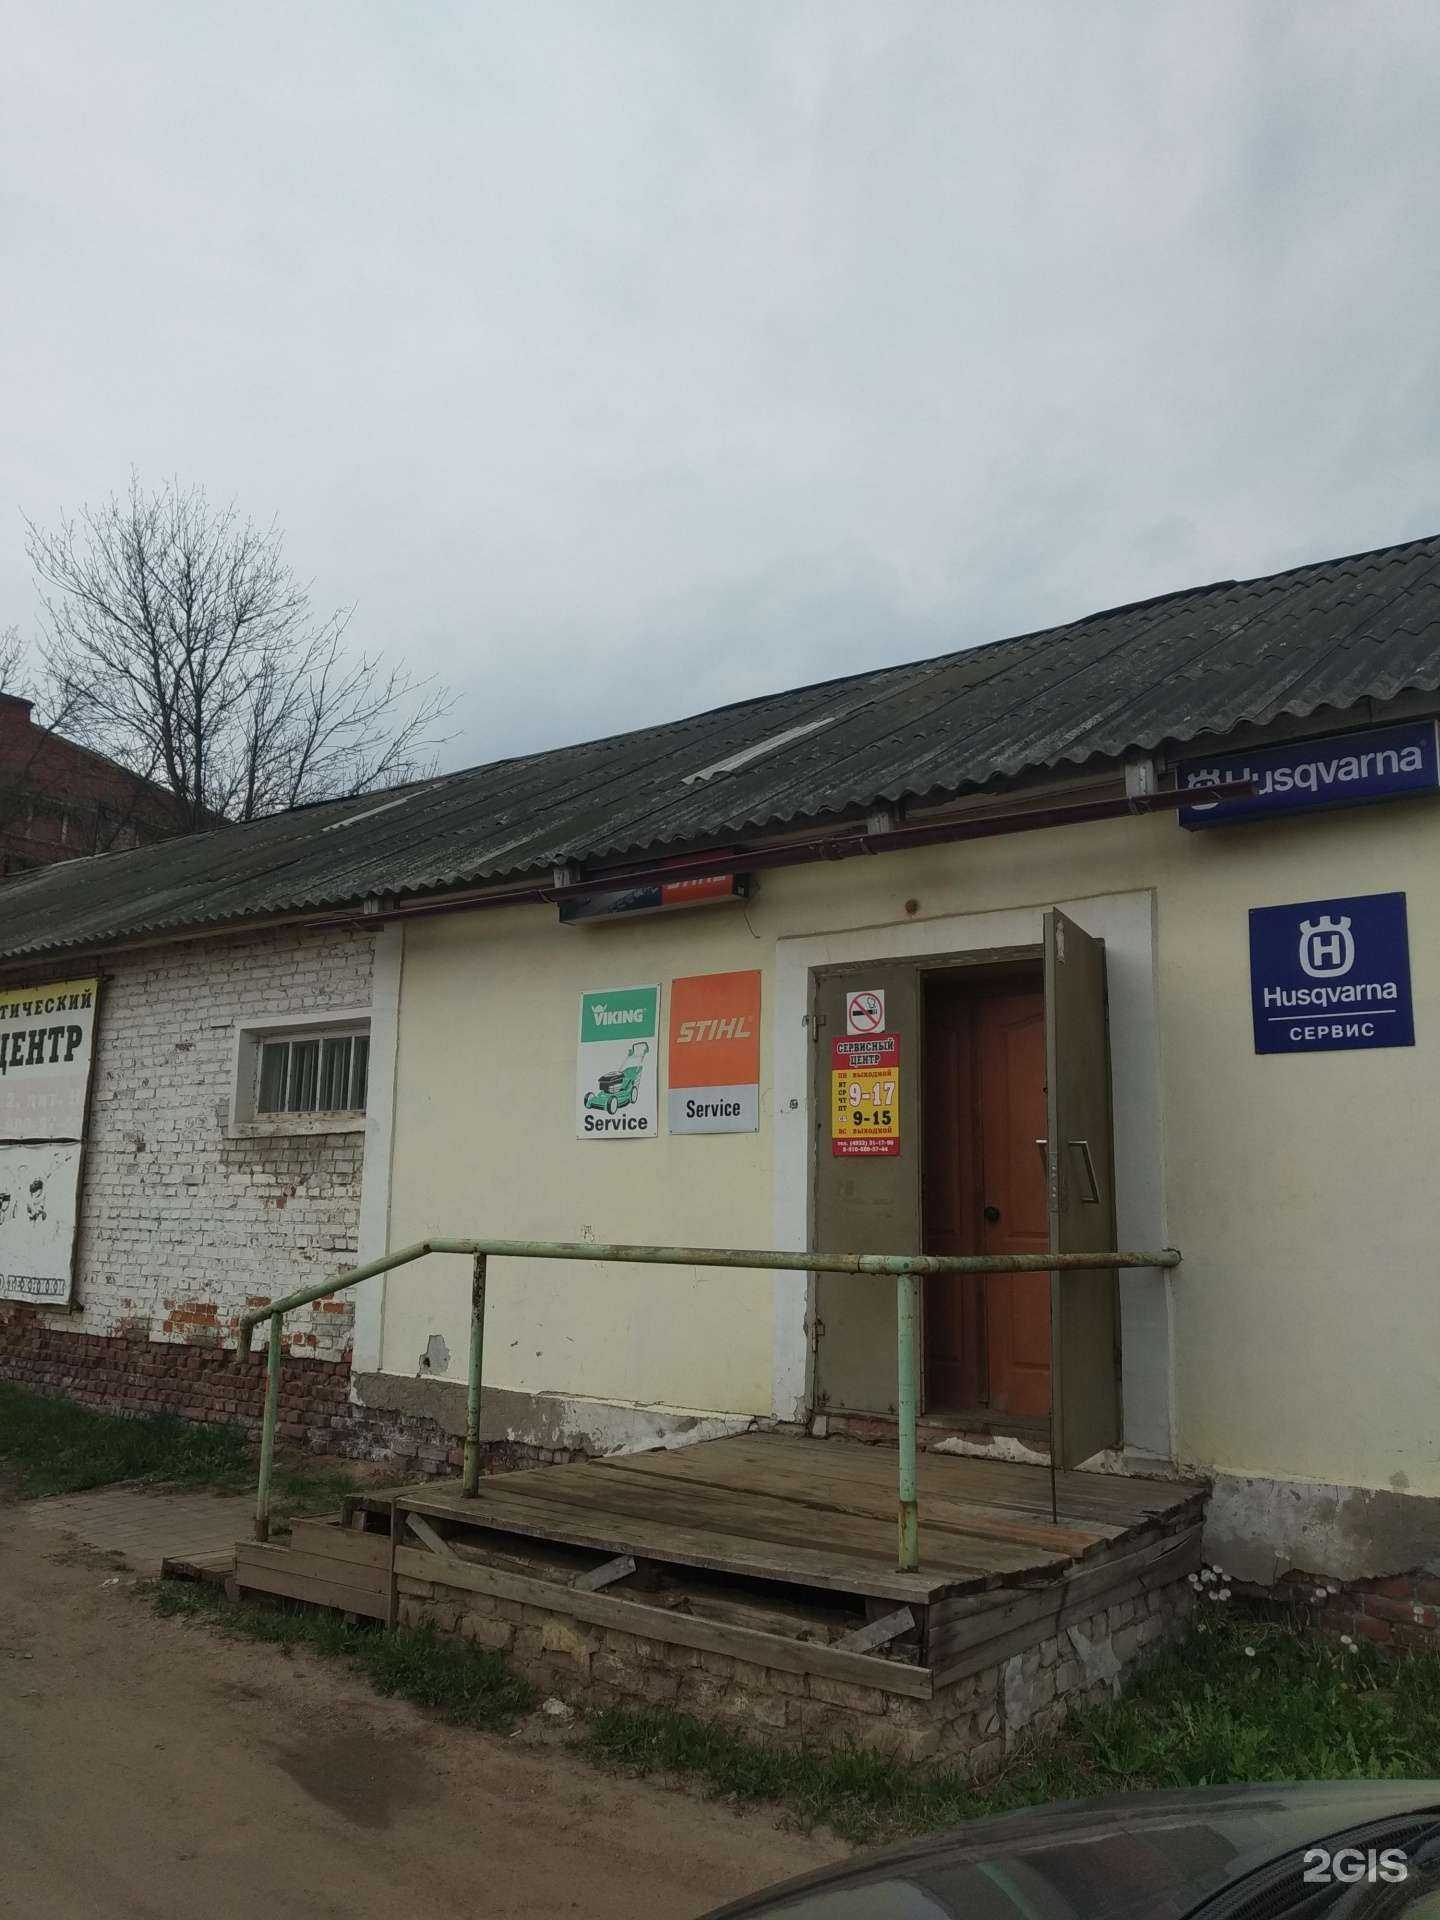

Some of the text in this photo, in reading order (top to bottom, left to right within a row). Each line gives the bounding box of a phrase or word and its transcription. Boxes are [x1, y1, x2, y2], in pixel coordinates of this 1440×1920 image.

[1264, 982, 1398, 1008] Husqvarna
[594, 1008, 644, 1026] VIKING
[676, 1017, 751, 1044] STIHL
[1289, 1022, 1375, 1041] СЕРВИС
[837, 1037, 895, 1055] СЕРВИСНЫЙ
[849, 1053, 881, 1068] ЦЕНТР
[849, 1081, 896, 1107] 9-17
[686, 1098, 741, 1118] Service
[584, 1113, 648, 1132] Service
[853, 1110, 892, 1126] 9-15
